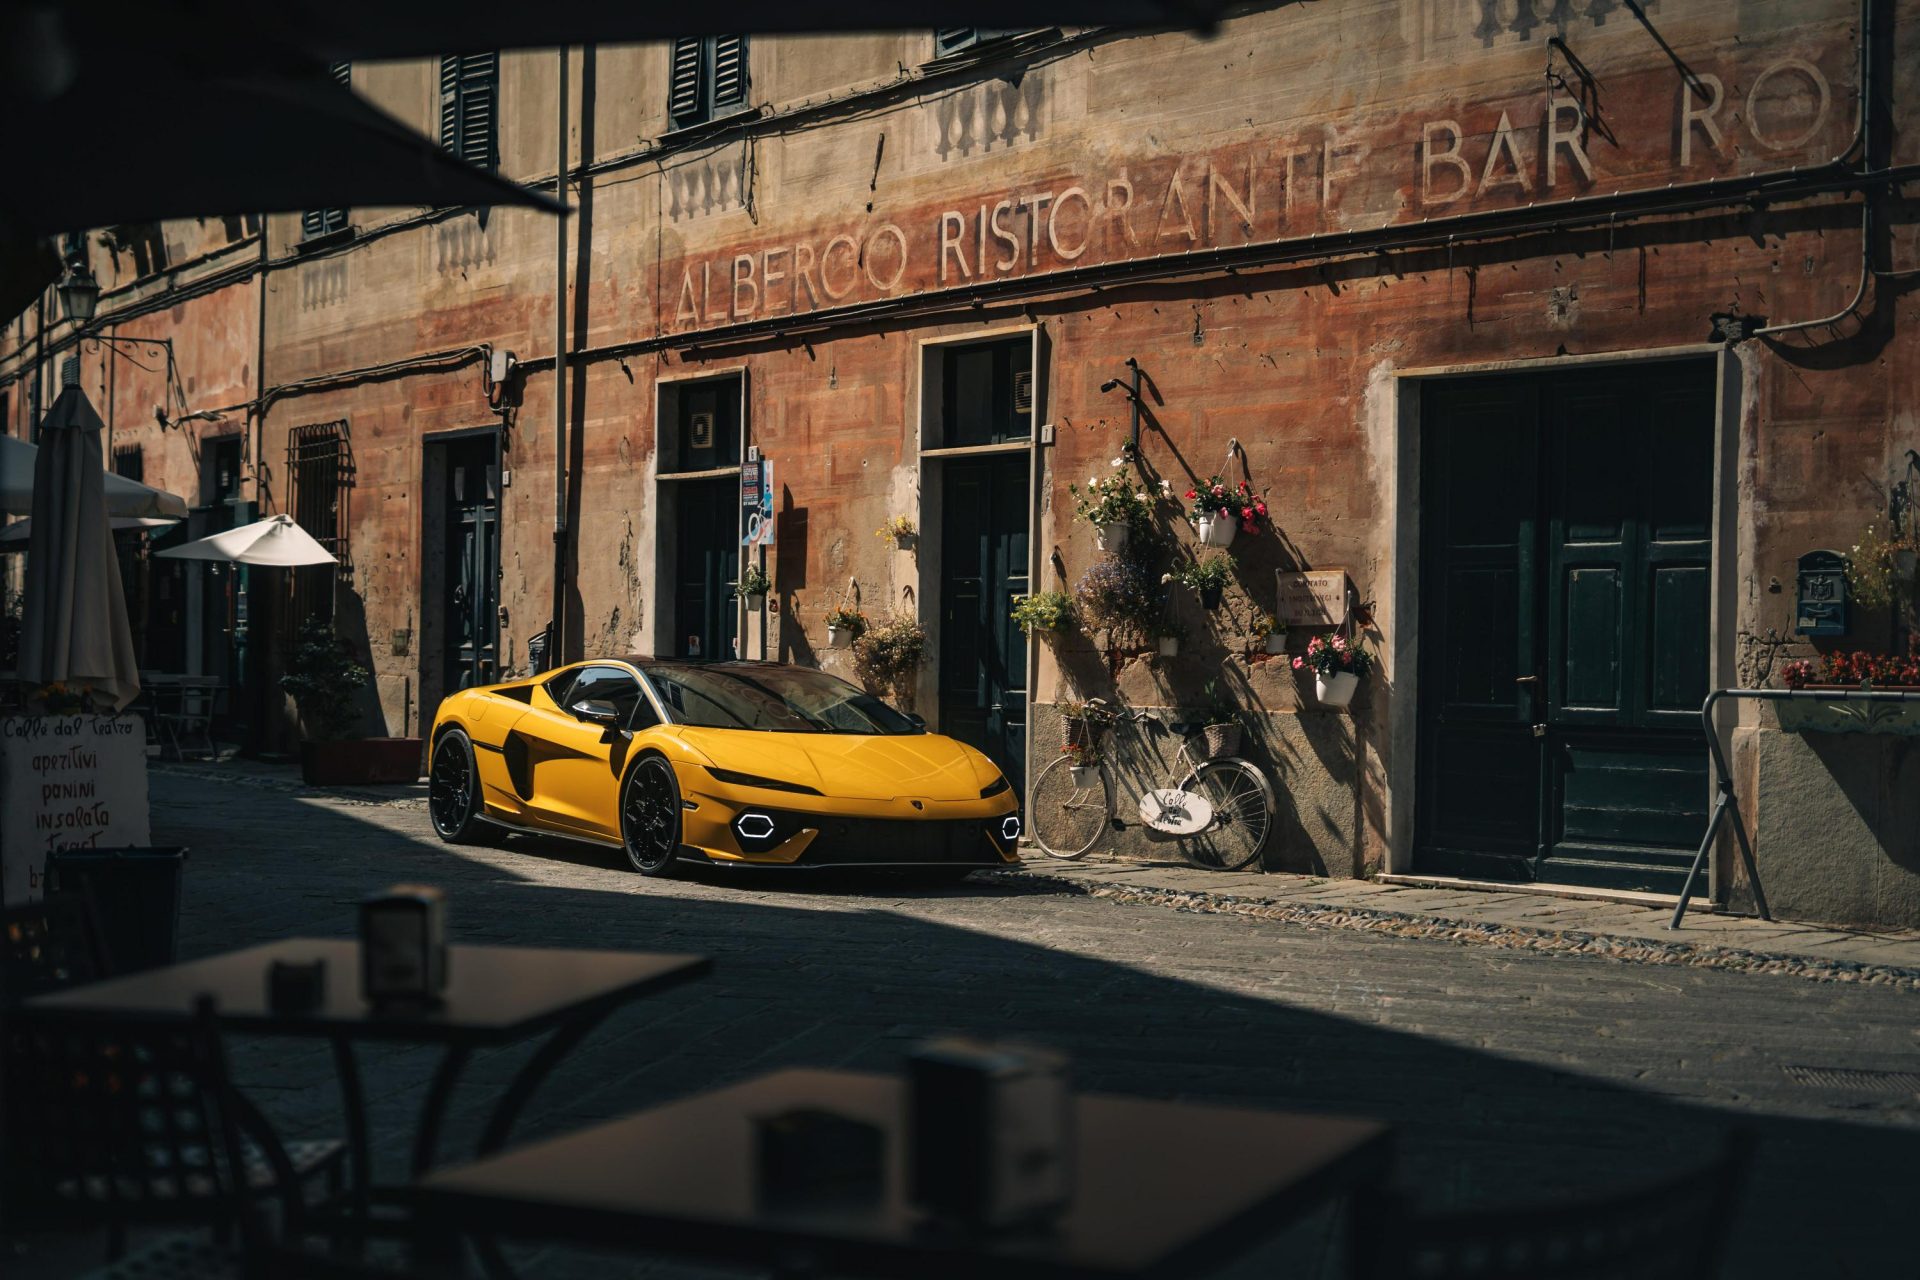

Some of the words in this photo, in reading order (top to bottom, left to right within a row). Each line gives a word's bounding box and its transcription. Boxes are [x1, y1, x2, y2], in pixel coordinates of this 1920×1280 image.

[1422, 98, 1593, 204] BAR
[1681, 58, 1831, 167] RO
[32, 745, 97, 777] aperitivi
[42, 780, 95, 805] panini
[36, 802, 109, 829] insalata
